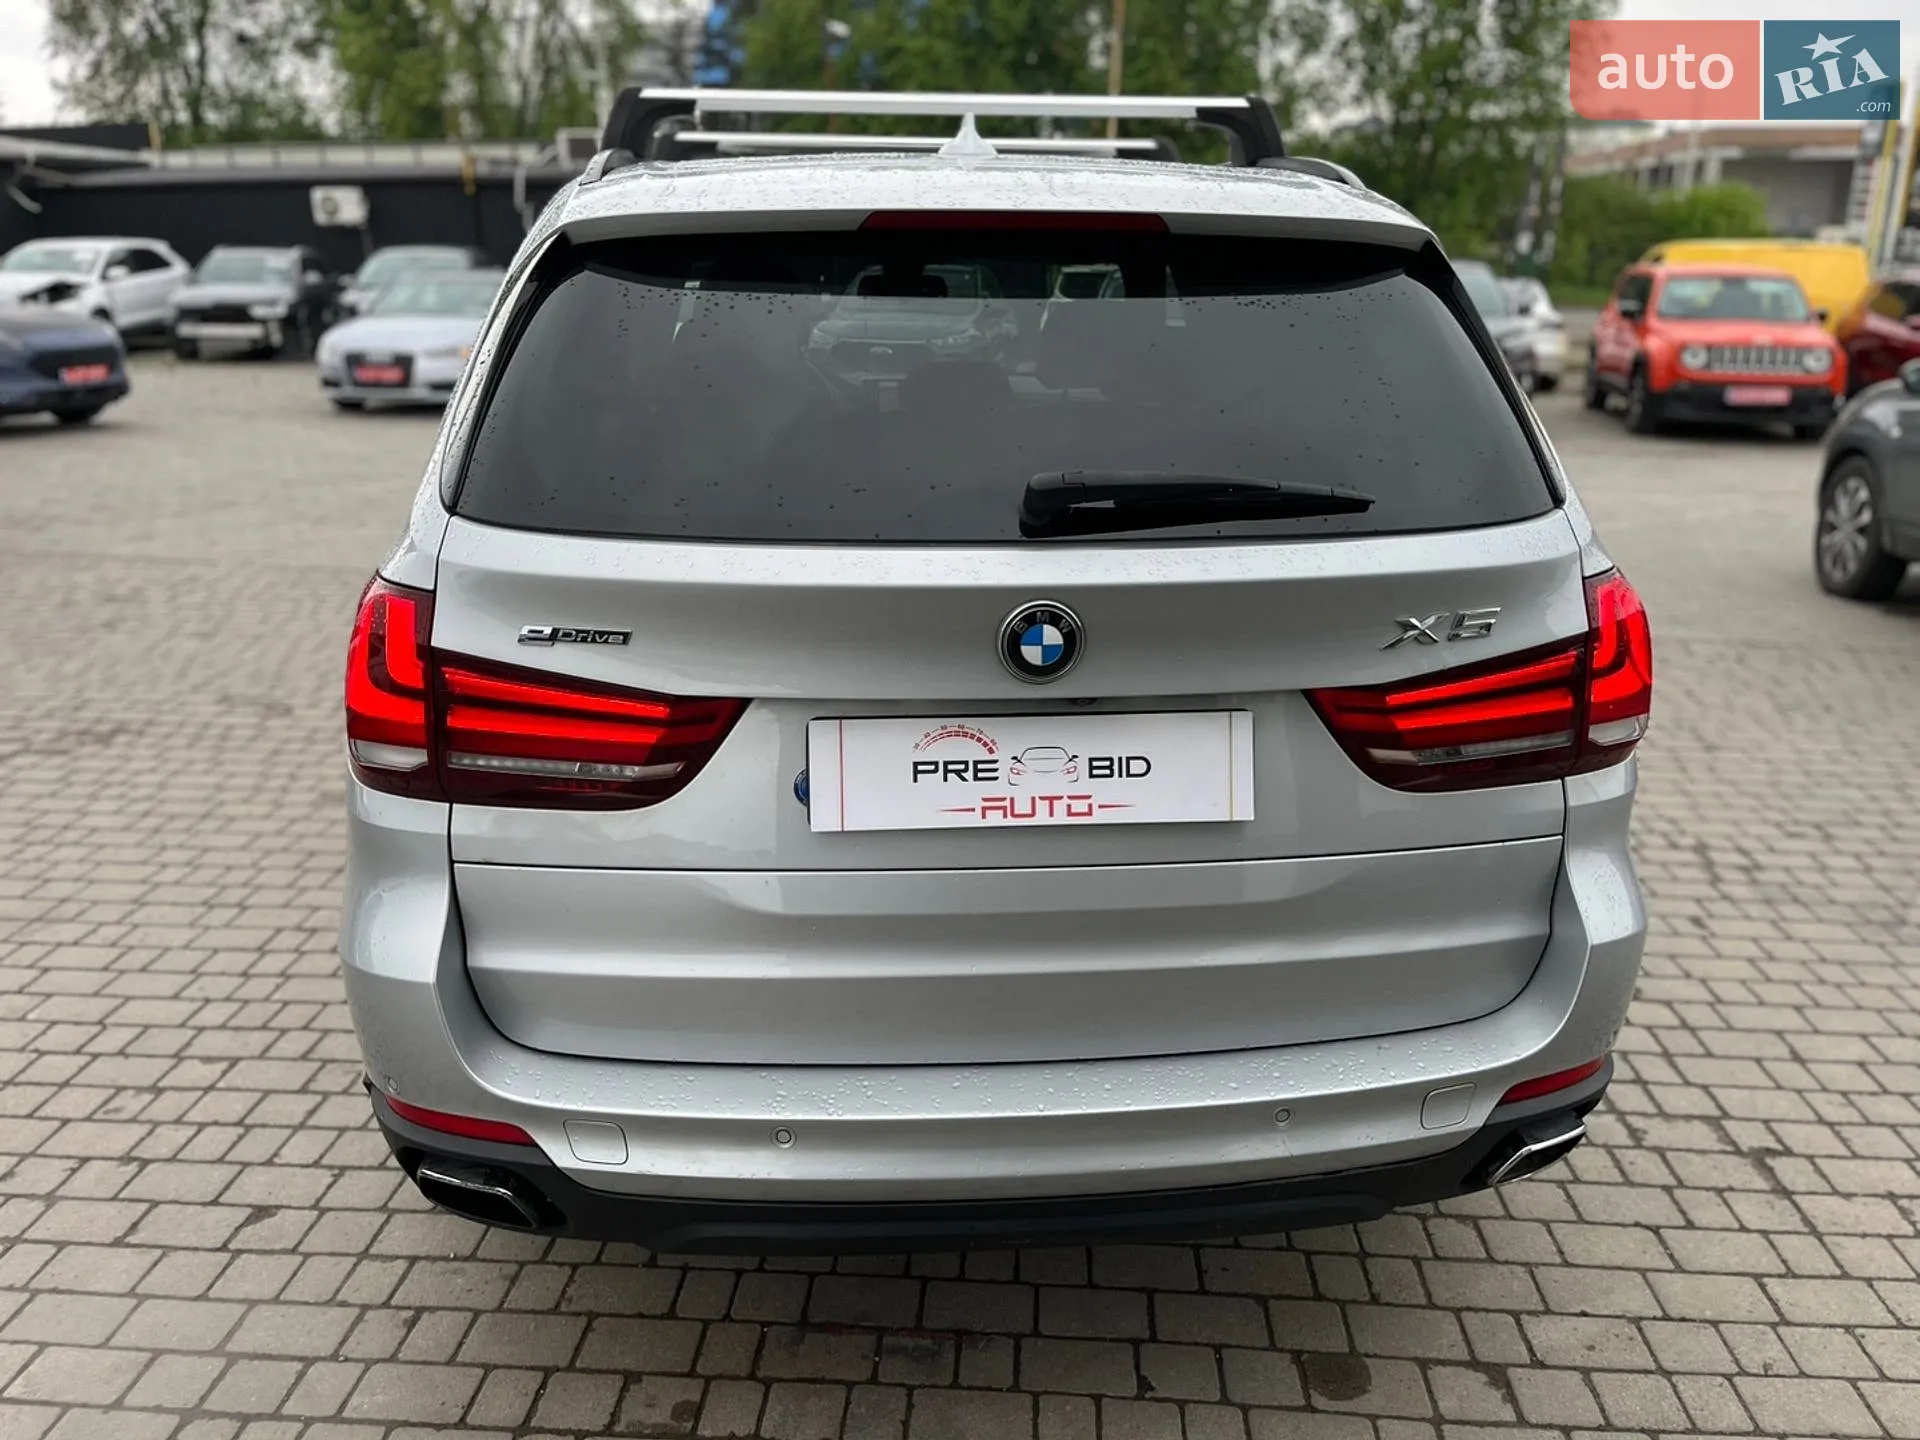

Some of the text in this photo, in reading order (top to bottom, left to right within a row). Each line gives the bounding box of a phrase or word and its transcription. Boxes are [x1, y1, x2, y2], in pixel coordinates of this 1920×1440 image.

[1013, 611, 1072, 634] BMW
[1379, 607, 1502, 650] X5
[912, 756, 1152, 783] PRE BID
[981, 795, 1093, 819] AUTO
